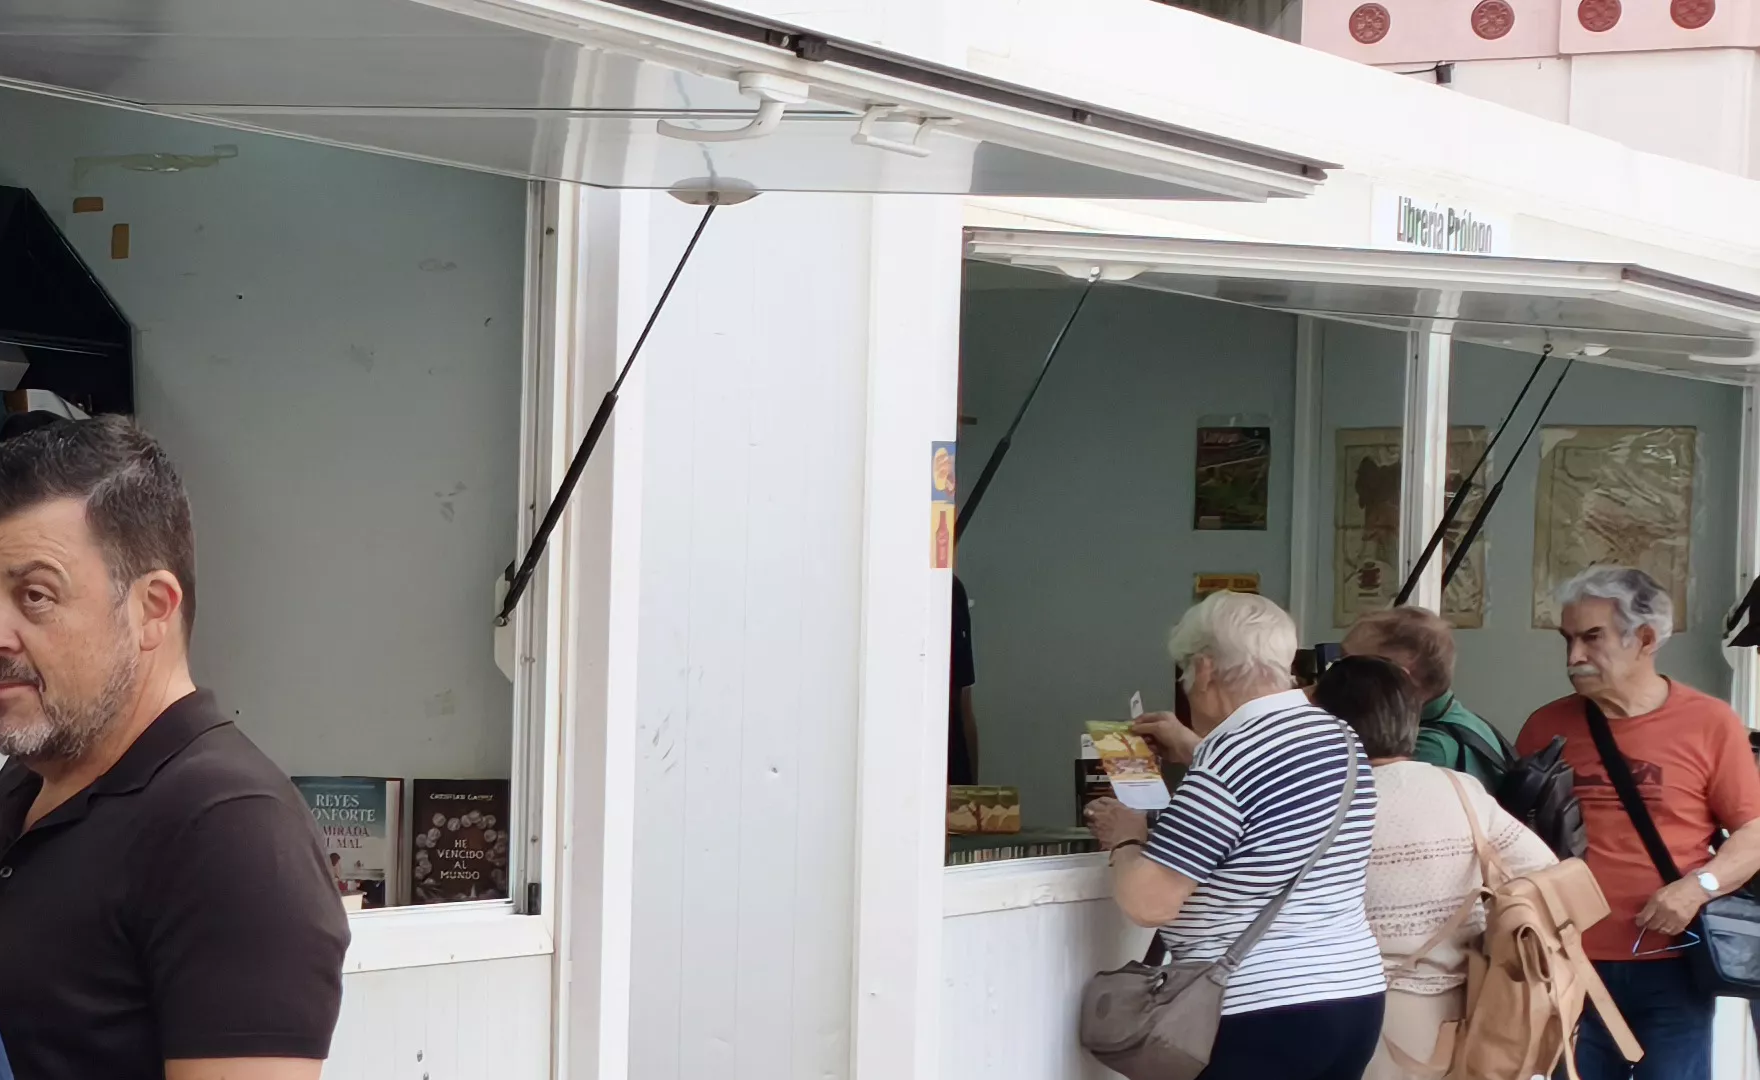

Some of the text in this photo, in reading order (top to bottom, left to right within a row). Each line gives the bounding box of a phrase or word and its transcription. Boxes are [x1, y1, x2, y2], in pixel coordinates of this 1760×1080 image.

[1397, 195, 1444, 250] Librería
[316, 794, 360, 808] REYES
[309, 807, 376, 822] ONFORTE
[454, 839, 467, 848] HE
[437, 849, 484, 859] VENCIDO
[453, 860, 467, 870] AL
[440, 870, 480, 880] MUNDO
